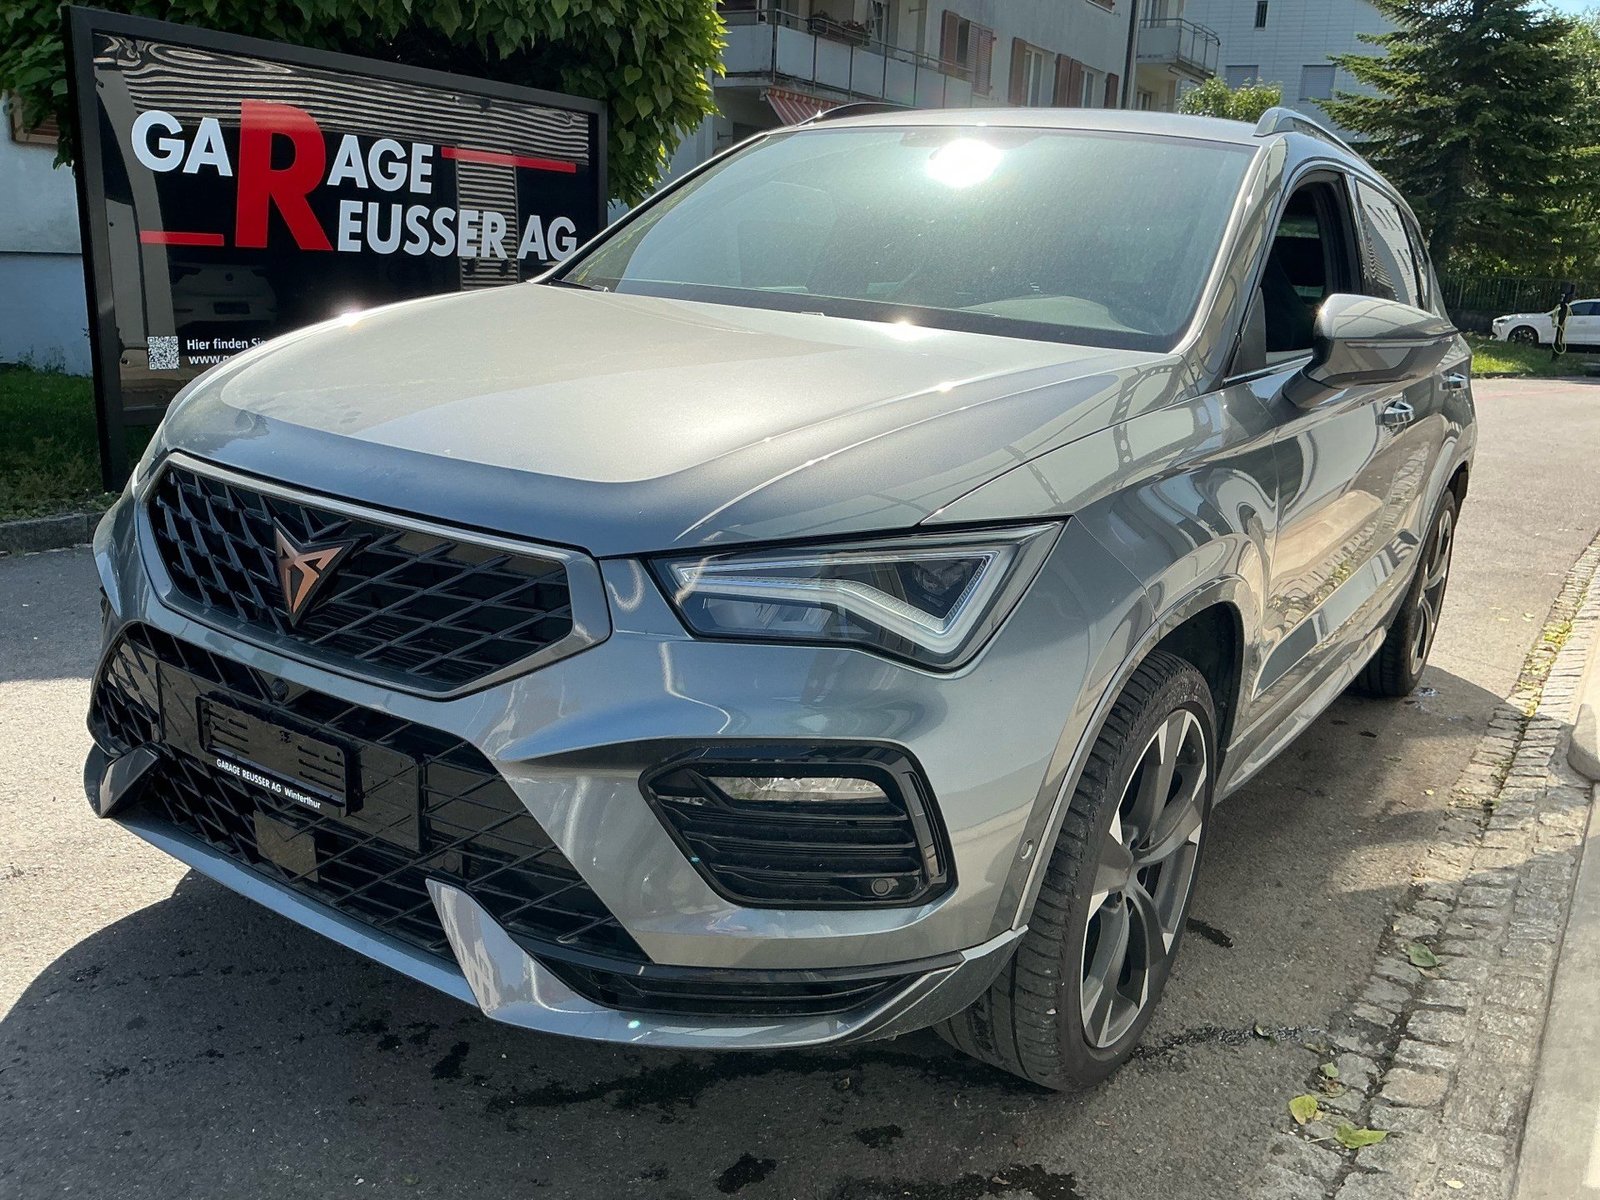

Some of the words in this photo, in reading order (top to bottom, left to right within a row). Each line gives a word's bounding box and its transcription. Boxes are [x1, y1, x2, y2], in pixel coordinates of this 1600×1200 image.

[516, 214, 578, 261] AG
[186, 338, 210, 350] Hier
[212, 337, 249, 350] finden
[216, 758, 241, 776] GARAGE
[241, 769, 270, 789] REUSSER
[271, 782, 282, 793] AG
[284, 787, 321, 809] Winterthur
